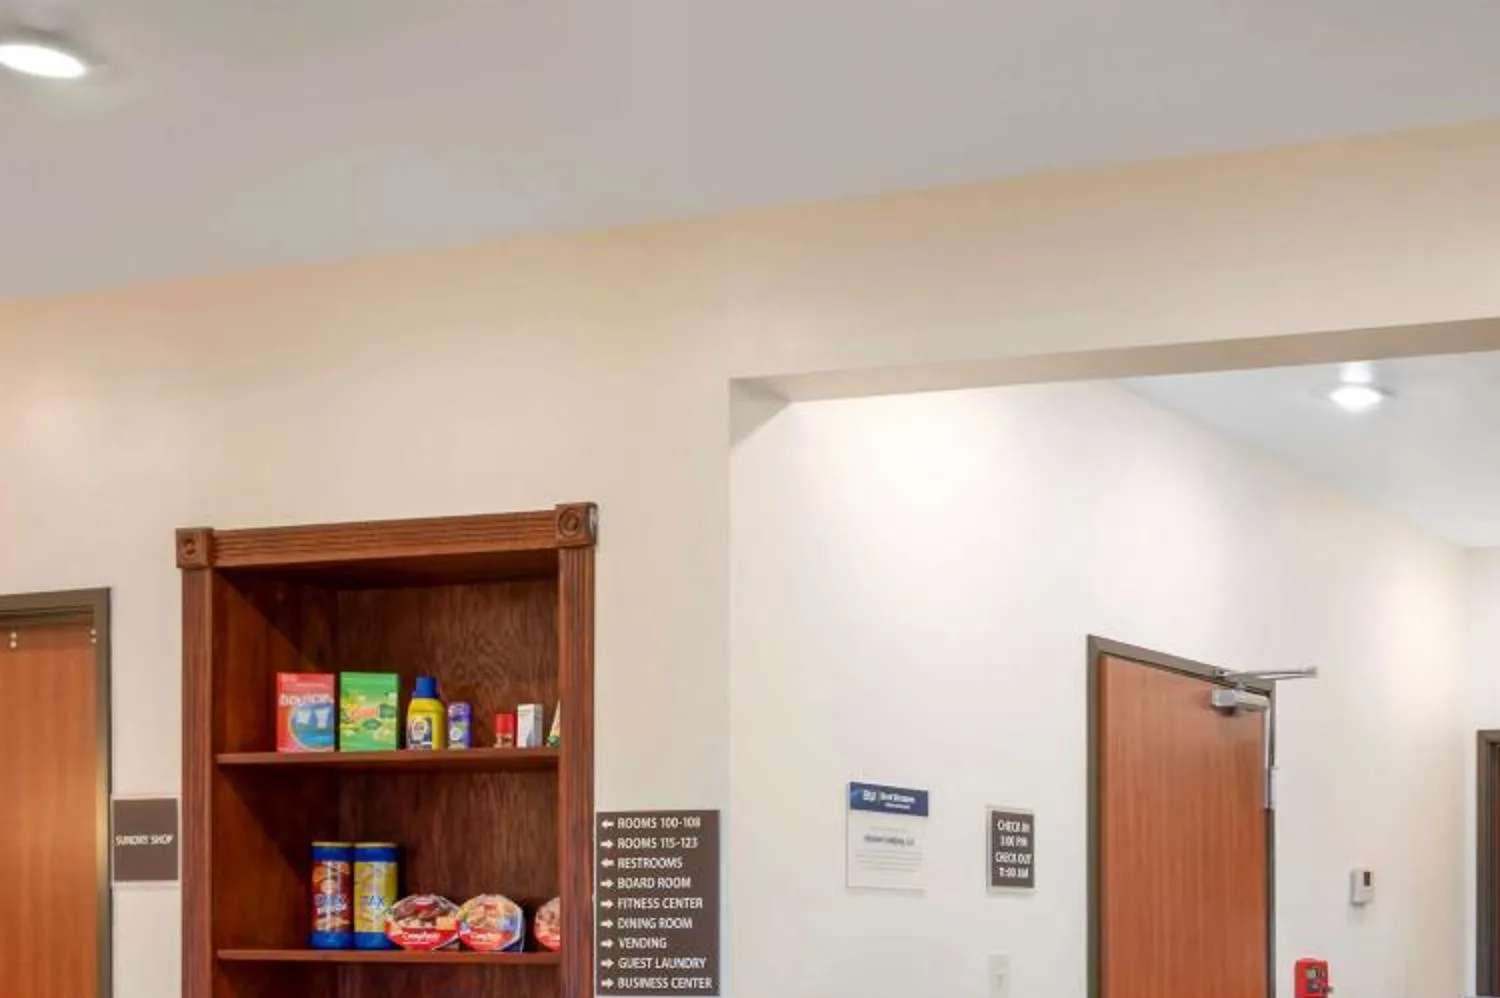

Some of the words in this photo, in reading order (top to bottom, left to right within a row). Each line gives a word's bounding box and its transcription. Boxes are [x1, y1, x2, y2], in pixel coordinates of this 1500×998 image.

[617, 817, 657, 829] ROOMS
[617, 837, 657, 849] ROOMS
[661, 837, 699, 849] 115-123
[617, 857, 683, 869] RESTROOMS
[995, 851, 1016, 863] CHECK
[1017, 852, 1032, 865] OUT
[617, 877, 655, 889] BOARD
[657, 877, 691, 889] ROOM
[617, 897, 660, 909] FITNESS
[661, 897, 703, 909] CENTER
[617, 917, 657, 929] DINING
[658, 917, 693, 929] ROOM
[618, 937, 667, 949] VENDING
[618, 957, 652, 969] GUEST
[654, 957, 707, 969] LAUNDRY
[617, 977, 669, 989] BUSINESS
[670, 977, 713, 989] CENTER
